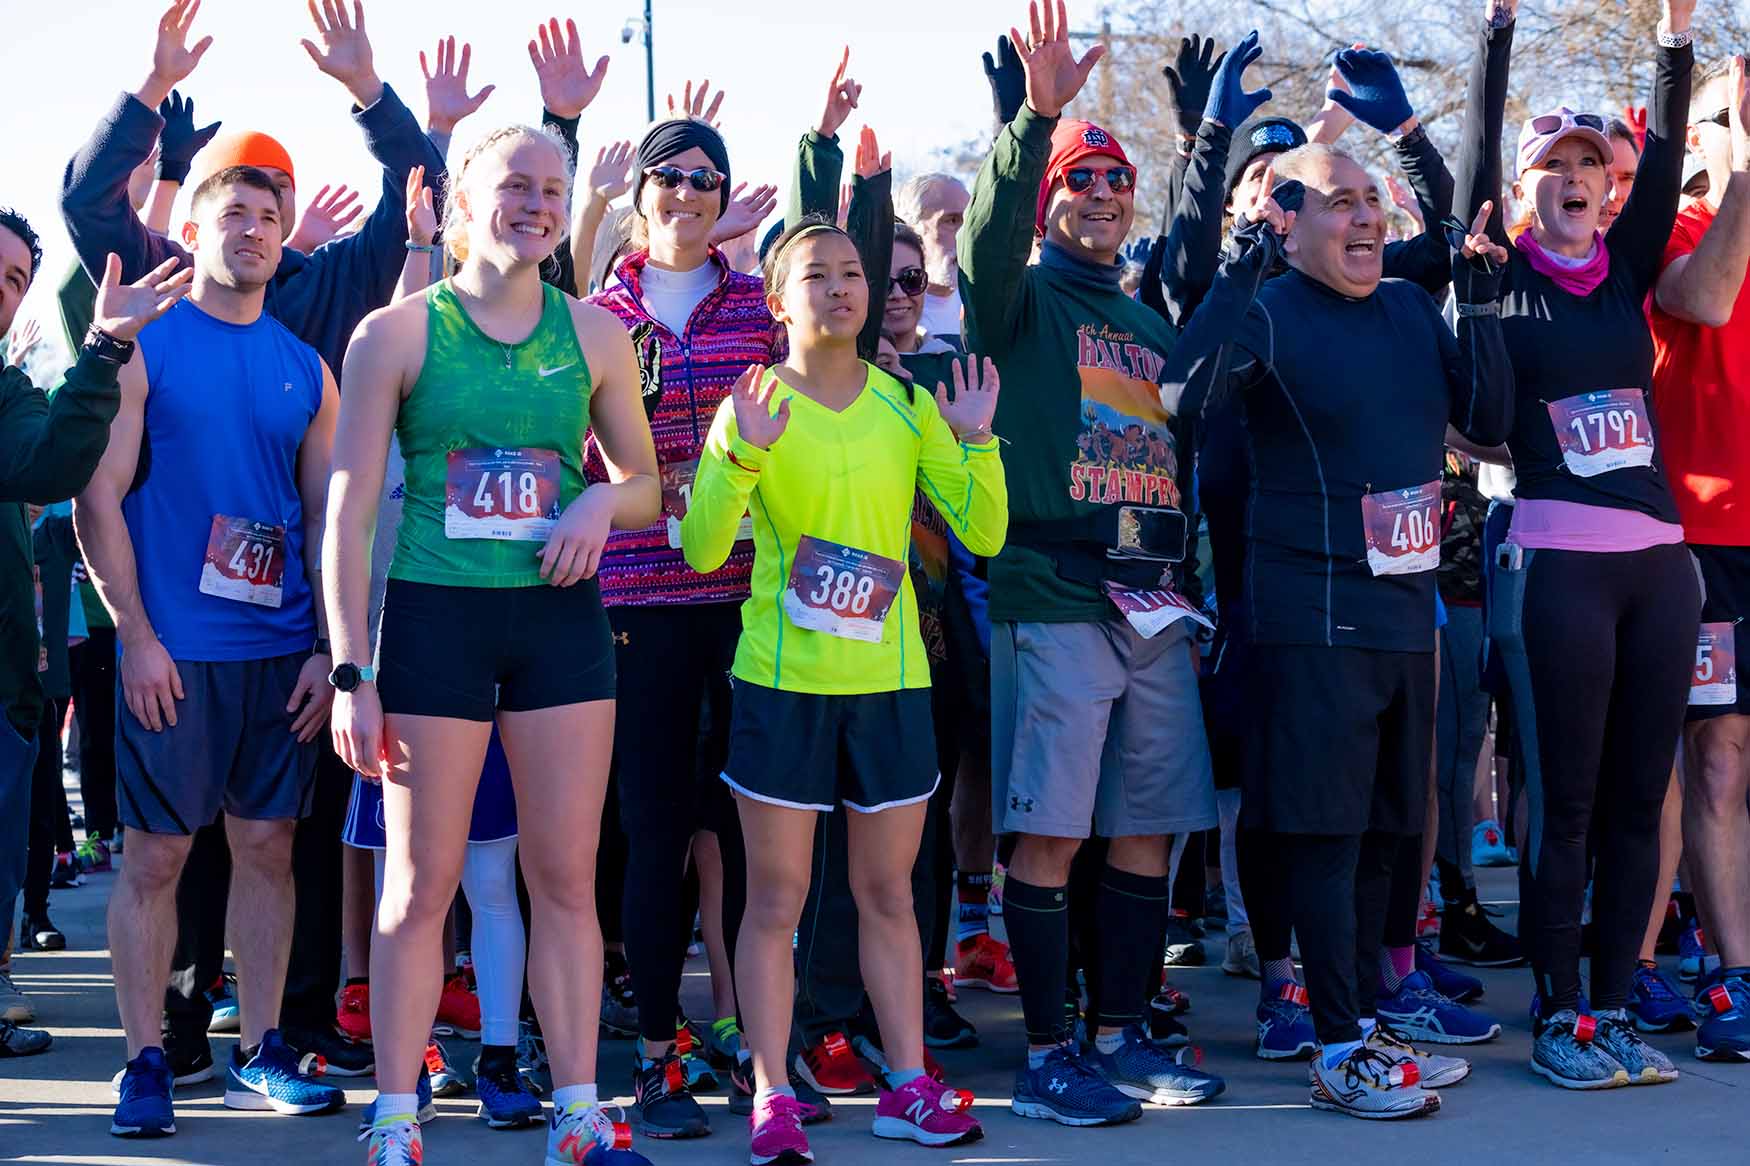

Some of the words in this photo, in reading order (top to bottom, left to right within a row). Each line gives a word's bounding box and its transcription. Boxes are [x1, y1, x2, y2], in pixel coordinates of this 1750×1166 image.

[1570, 409, 1647, 452] 1792
[473, 471, 538, 514] 418
[1391, 506, 1434, 552] 406
[228, 540, 275, 582] 431
[810, 564, 875, 615] 388
